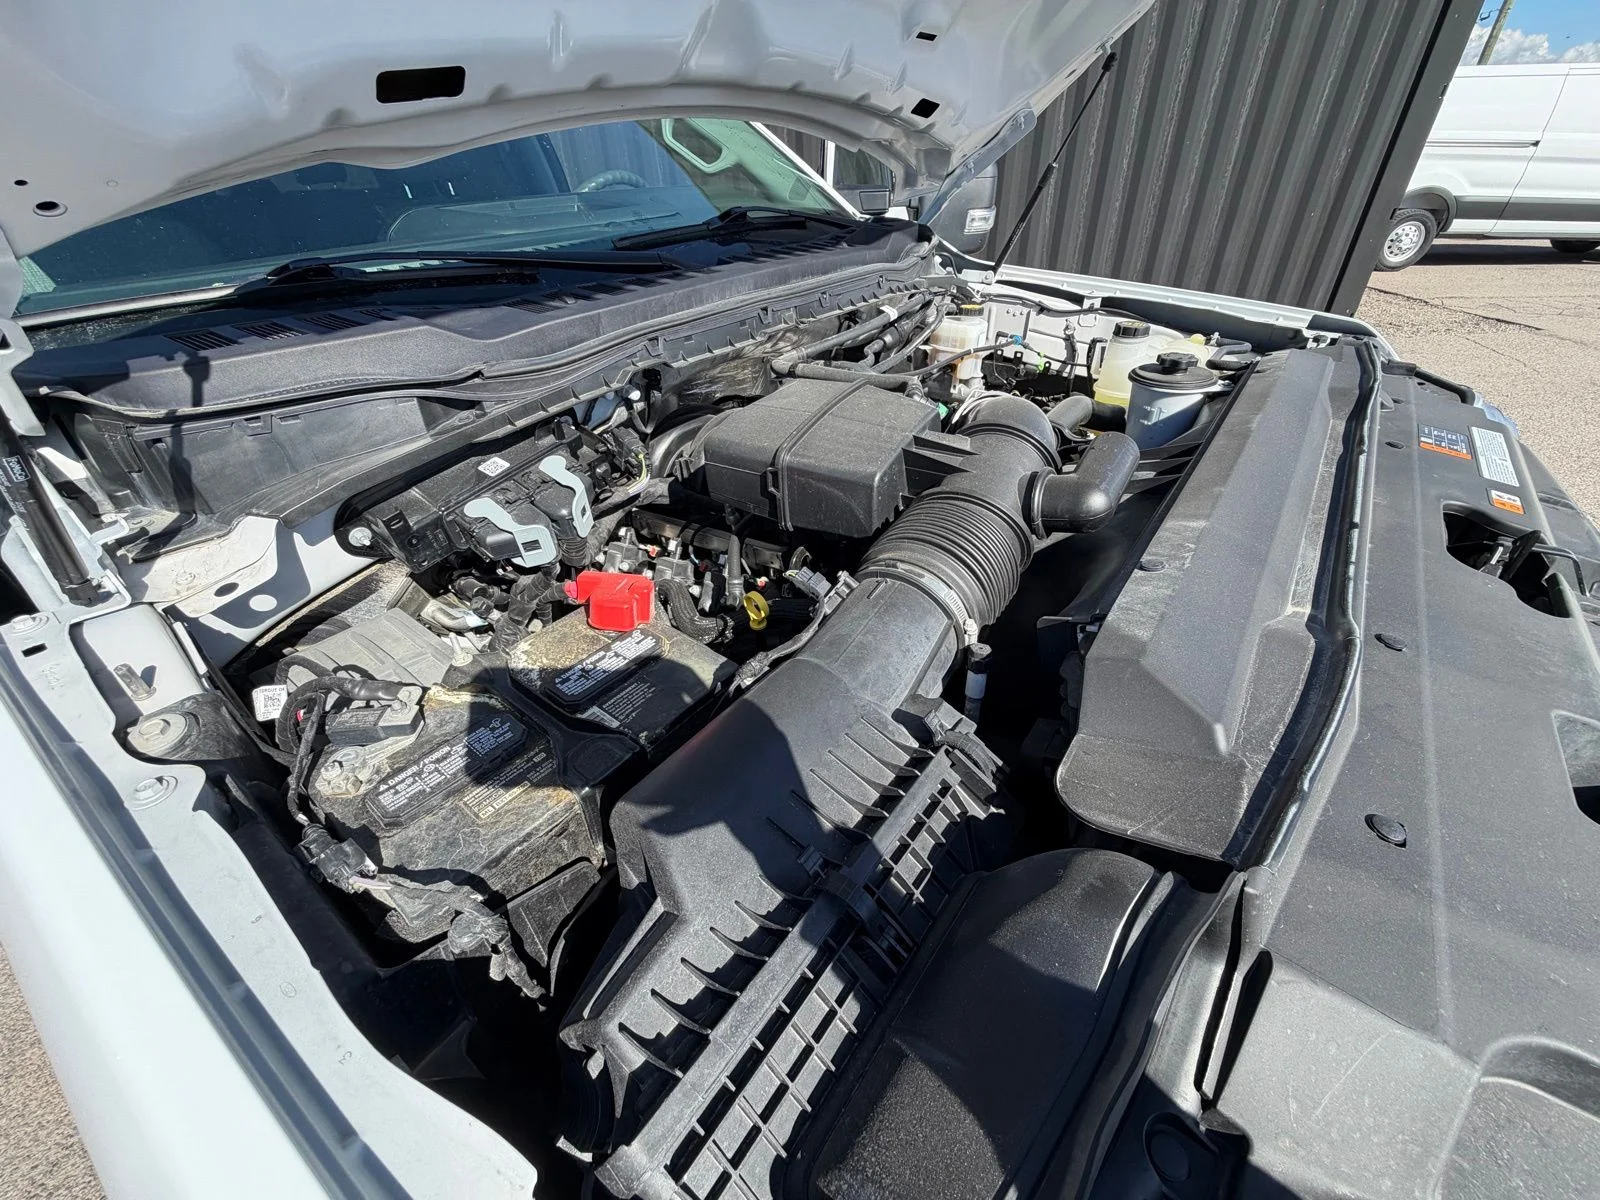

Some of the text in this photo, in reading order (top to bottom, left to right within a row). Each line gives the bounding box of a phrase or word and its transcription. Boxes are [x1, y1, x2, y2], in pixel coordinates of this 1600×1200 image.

[8, 458, 25, 480] FoMoCo
[388, 764, 419, 785] DANGER
[424, 745, 450, 764] POISON
[475, 790, 504, 811] FoMoCo
